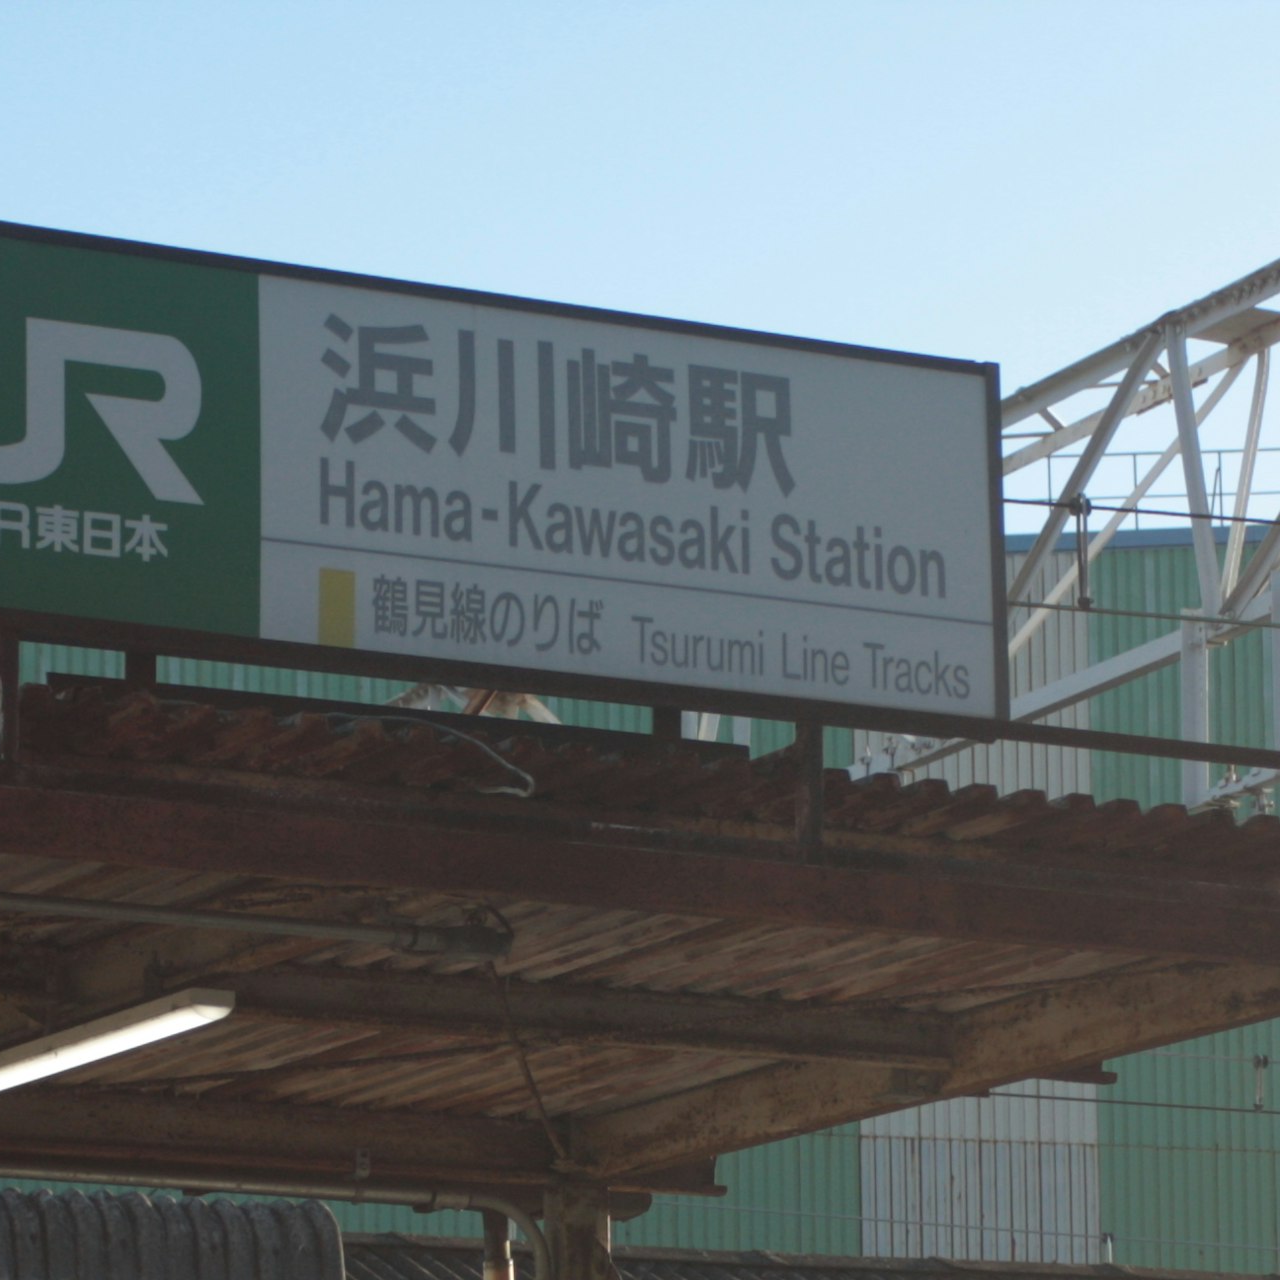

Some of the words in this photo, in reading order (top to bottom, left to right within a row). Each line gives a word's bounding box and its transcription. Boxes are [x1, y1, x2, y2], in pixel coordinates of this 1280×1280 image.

[319, 312, 798, 499] 浜川崎駅
[320, 457, 750, 576] Hama-Kawasaki
[770, 513, 947, 599] Station
[371, 573, 605, 656] 鶴見線のりば
[631, 615, 765, 677] Tsurumi
[782, 632, 850, 686] Line
[864, 643, 972, 700] Tracks
